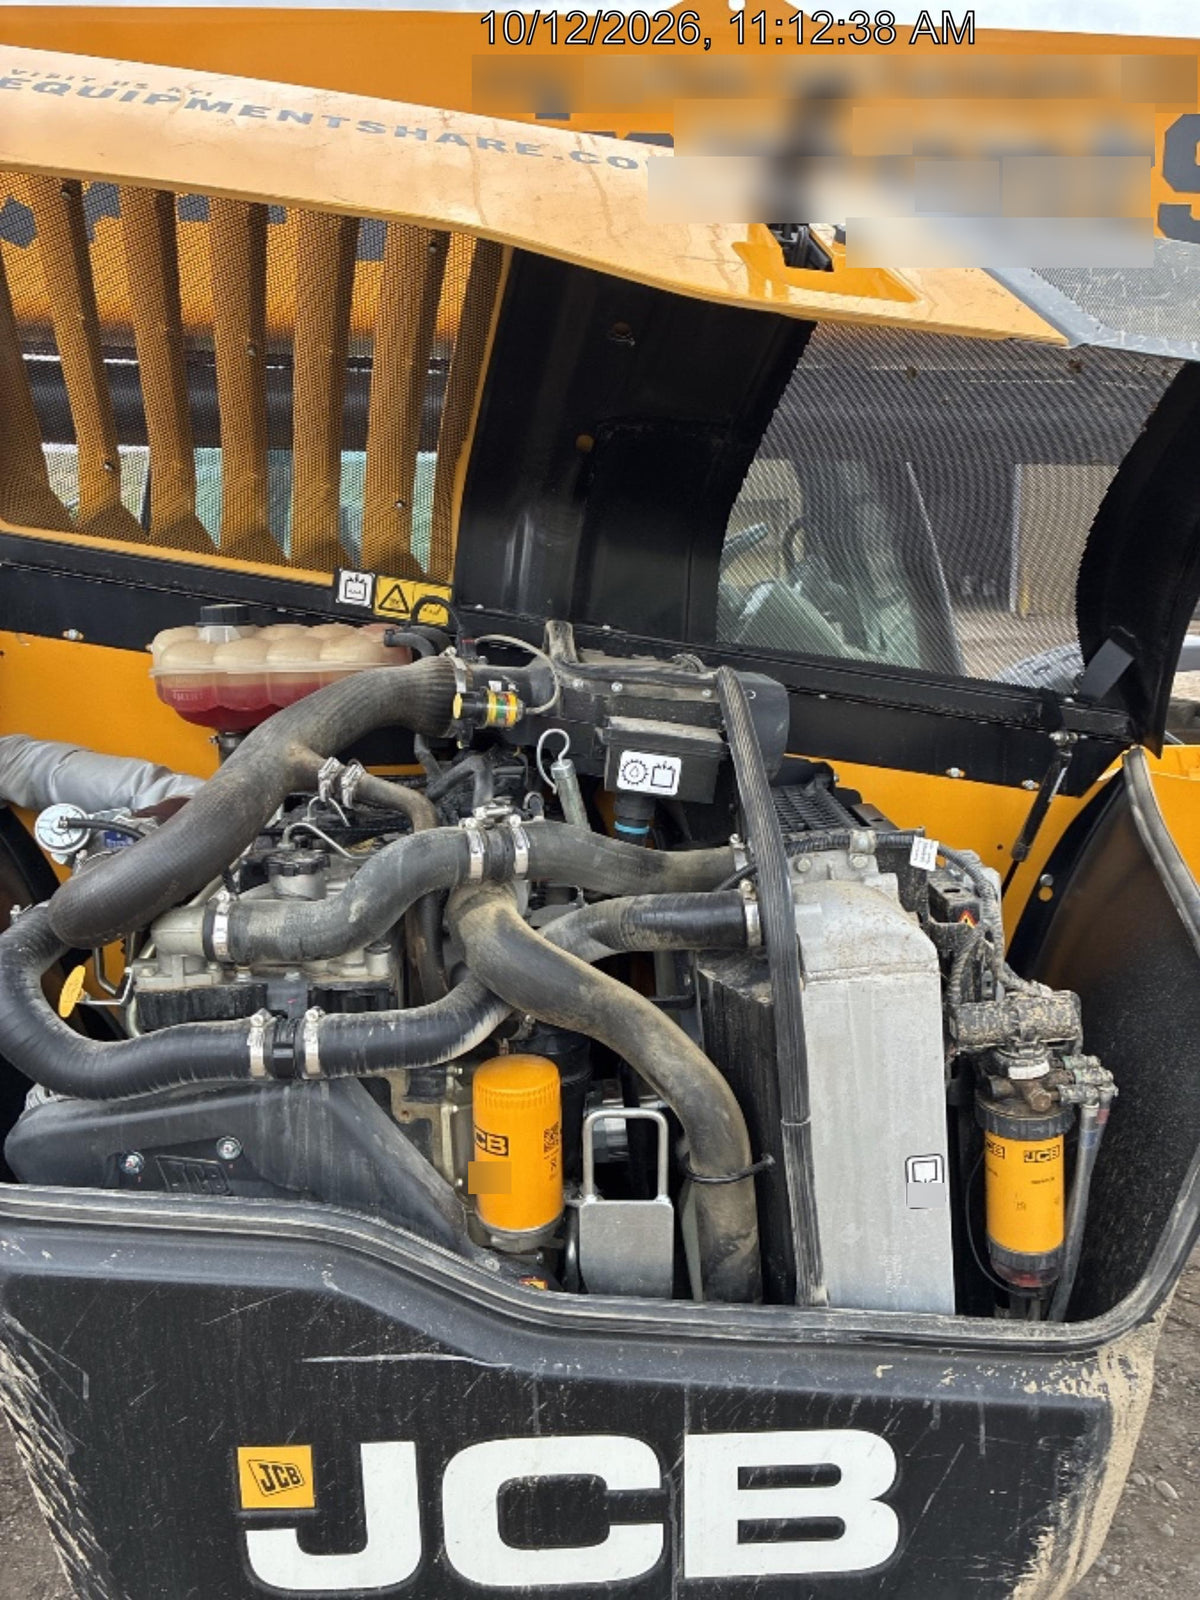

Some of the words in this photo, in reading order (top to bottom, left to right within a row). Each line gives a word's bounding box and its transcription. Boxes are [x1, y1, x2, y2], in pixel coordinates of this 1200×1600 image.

[0, 76, 648, 170] EQUIPMENTSHARE.CO
[246, 1428, 900, 1591] JCB
[258, 1464, 301, 1492] JCB
